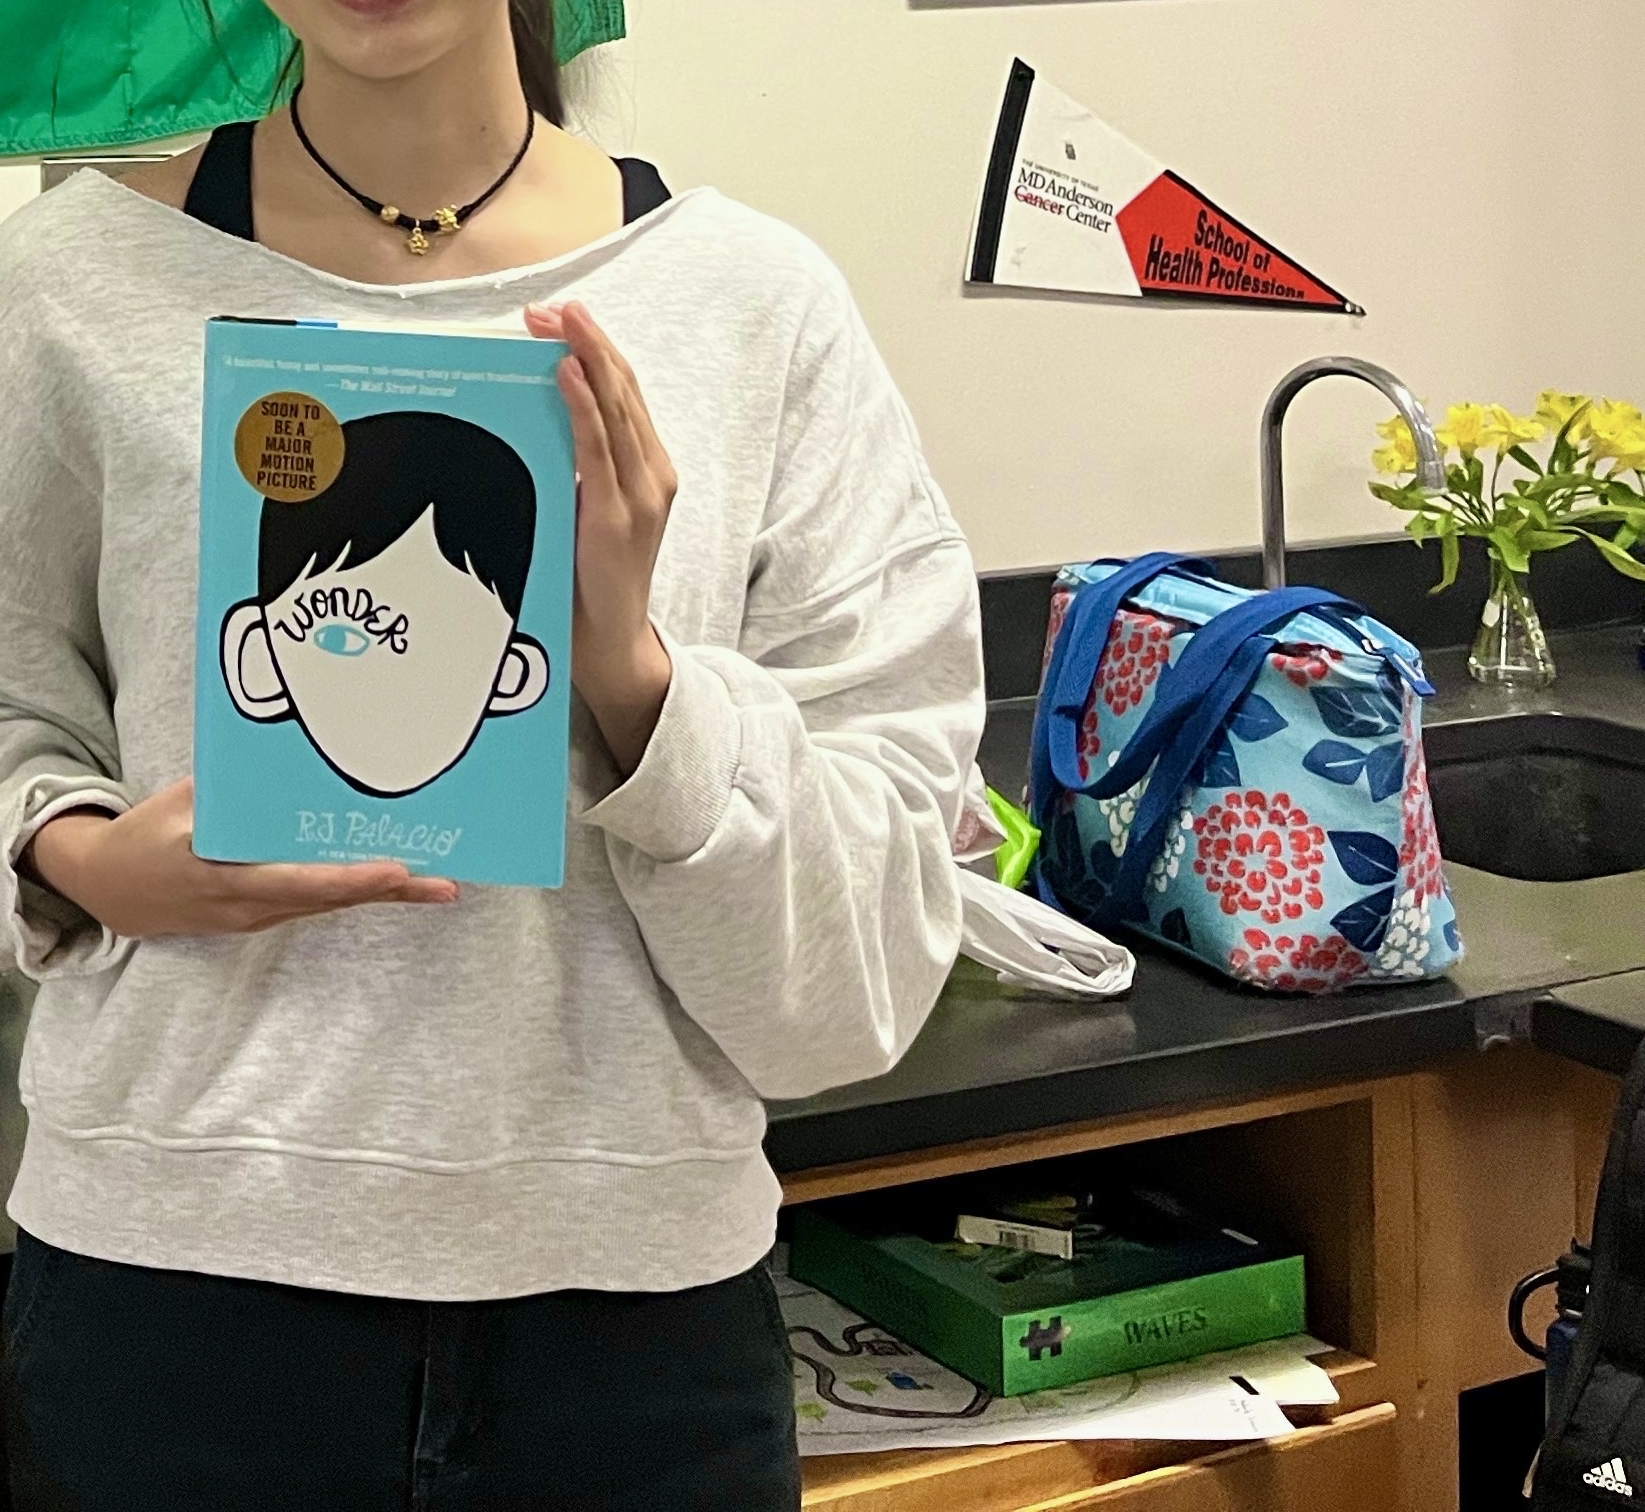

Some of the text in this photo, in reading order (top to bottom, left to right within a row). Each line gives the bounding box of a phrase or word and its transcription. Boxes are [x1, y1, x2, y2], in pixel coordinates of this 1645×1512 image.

[1017, 166, 1114, 217] MD Anderson
[1014, 184, 1112, 233] Cancer Center
[1194, 208, 1271, 273] School of
[1144, 233, 1305, 299] Health Professions
[261, 401, 320, 420] SOON TO
[274, 419, 305, 436] BE A
[265, 436, 312, 454] MAJOR
[260, 453, 314, 473] MOTION
[257, 471, 317, 491] PICTURE
[1122, 1305, 1207, 1346] WAVES
[1582, 1472, 1633, 1497] adidas
